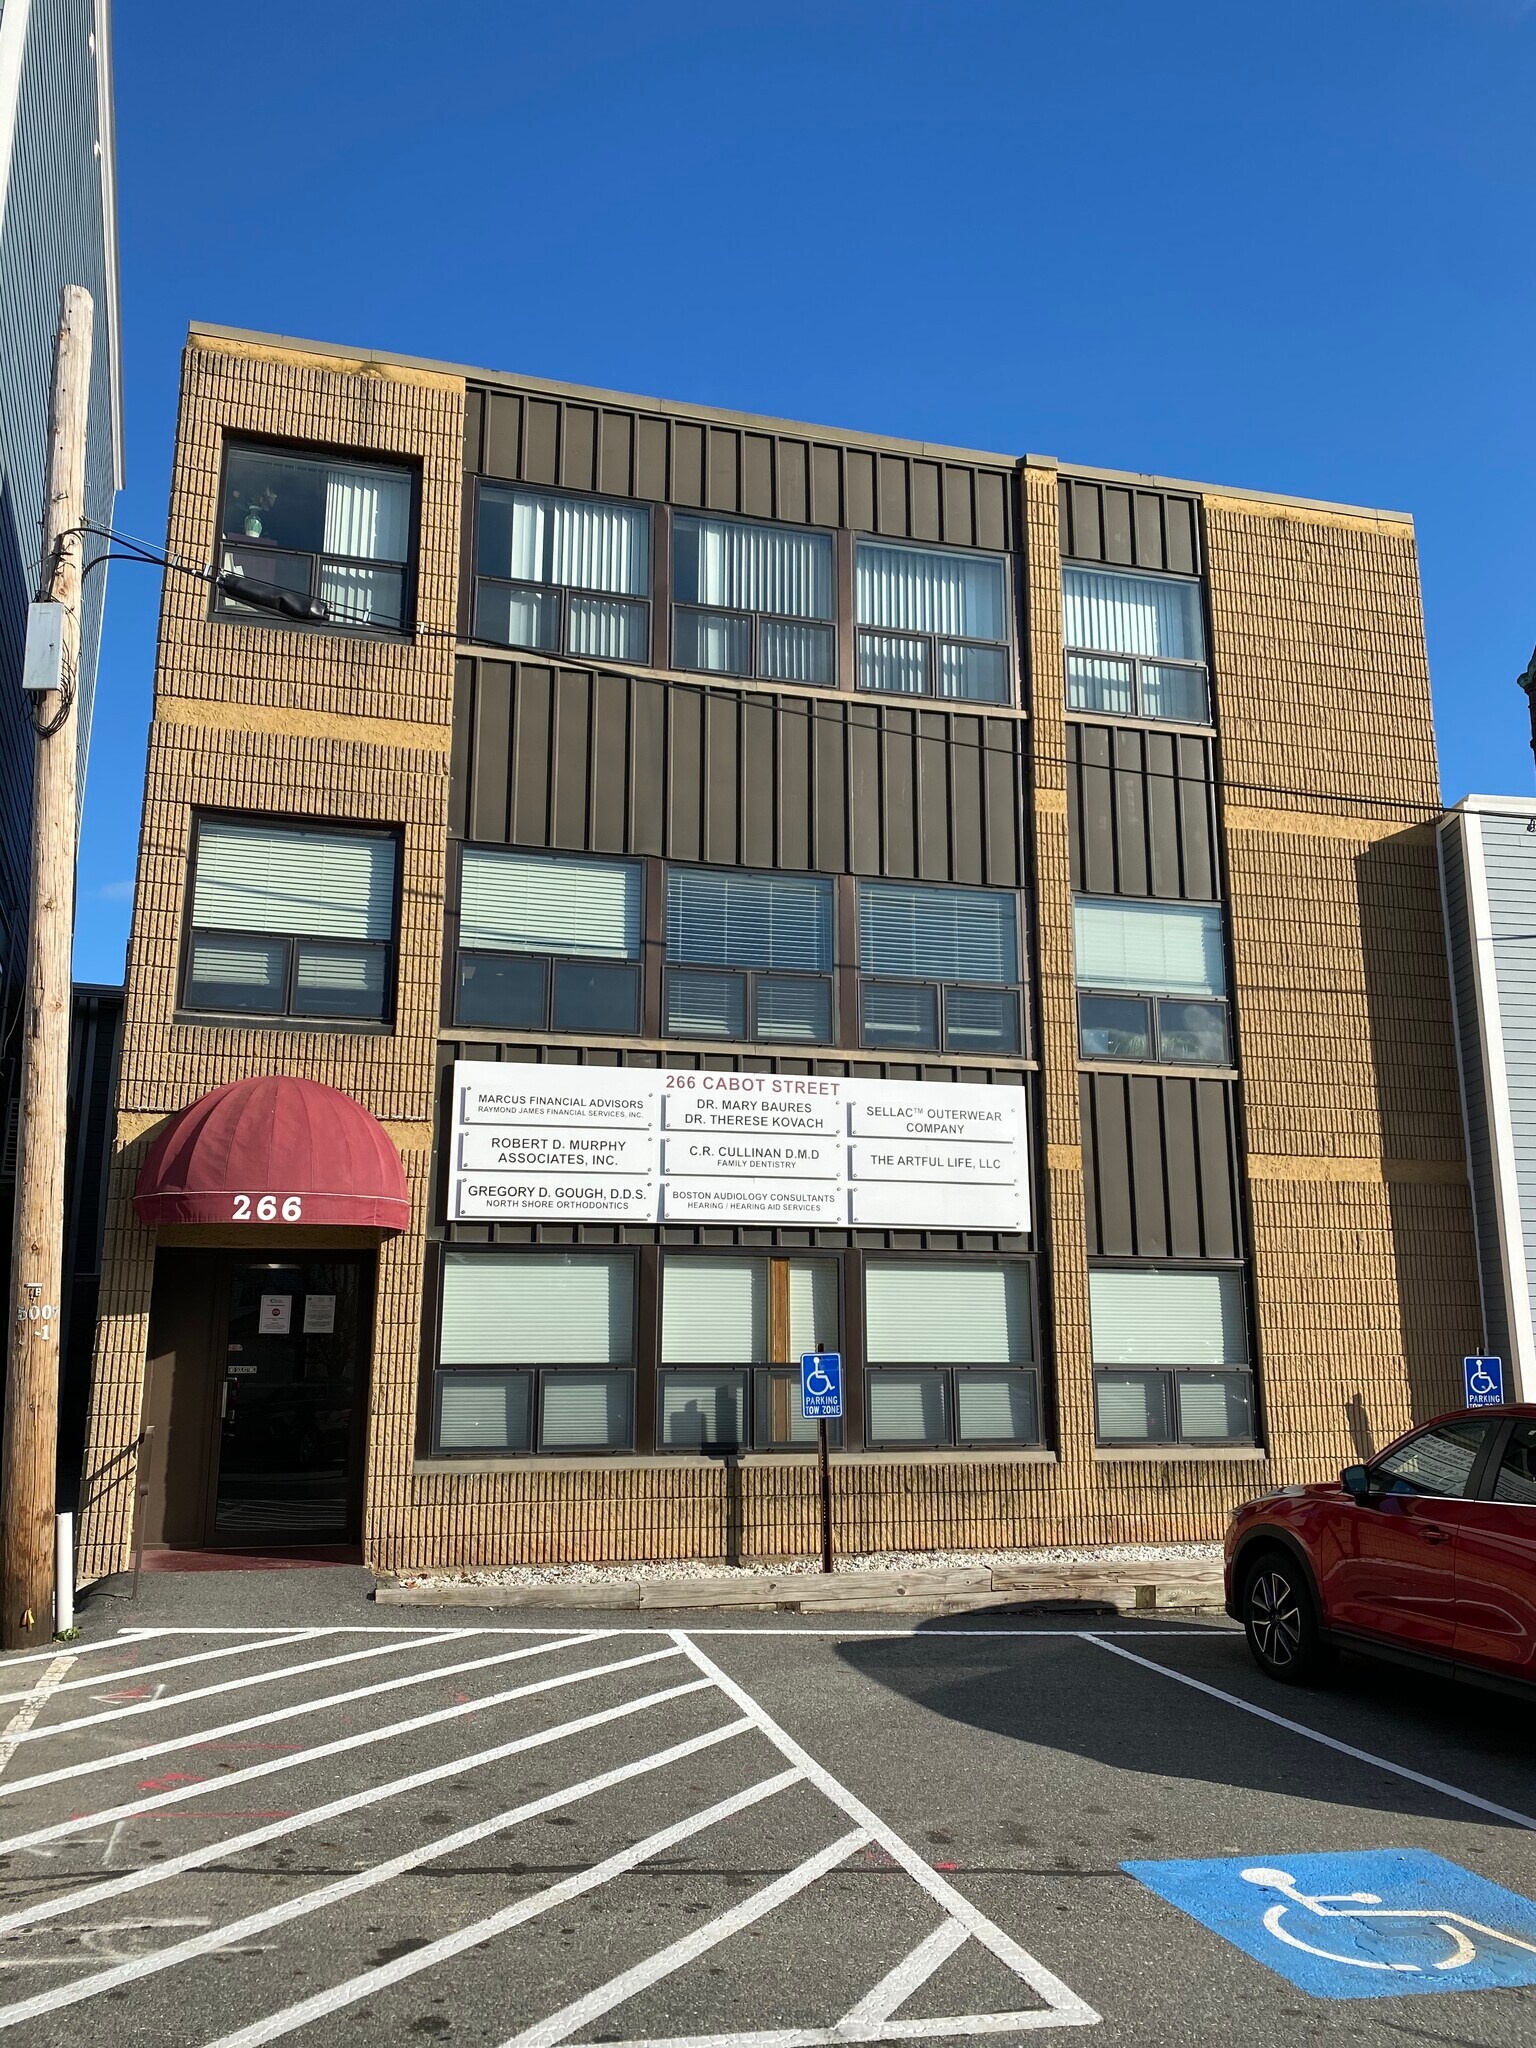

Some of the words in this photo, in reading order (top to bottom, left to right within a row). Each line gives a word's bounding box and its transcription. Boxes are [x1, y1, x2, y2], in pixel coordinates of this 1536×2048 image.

[666, 1075, 696, 1089] 266
[703, 1077, 765, 1092] CABOT
[772, 1080, 840, 1096] STREET
[478, 1095, 526, 1105] MARCUS
[530, 1096, 587, 1107] FINANCIAL
[589, 1099, 644, 1109] ADVISORS
[697, 1099, 718, 1110] DR.
[722, 1100, 758, 1112] MARY
[762, 1101, 812, 1113] BAURES
[478, 1106, 517, 1114] RAYMOND
[519, 1107, 545, 1115] JAMES
[547, 1108, 586, 1117] FINANCIAL
[588, 1110, 626, 1118] SERVICES,
[628, 1111, 643, 1119] INC.
[928, 1109, 1002, 1122] OUTERWEAR
[685, 1114, 706, 1125] DR.
[711, 1115, 769, 1127] THERESE
[772, 1117, 824, 1129] KOVACH
[906, 1123, 965, 1135] COMPANY
[491, 1137, 549, 1150] ROBERT
[552, 1140, 565, 1149] D.
[570, 1140, 626, 1152] MURPHY
[689, 1146, 714, 1157] C.R.
[718, 1147, 782, 1159] CULLINAN
[786, 1149, 820, 1160] D.M.D
[498, 1153, 588, 1167] ASSOCIATES,
[592, 1155, 618, 1166] INC.
[717, 1159, 747, 1168] FAMILY
[750, 1161, 797, 1169] DENTISTRY
[870, 1155, 895, 1165] THE
[897, 1156, 944, 1167] ARTFUL
[948, 1158, 976, 1170] LIFE,
[979, 1159, 1001, 1169] LLC
[468, 1185, 535, 1198] GREGORY
[538, 1187, 551, 1198] D.
[555, 1188, 607, 1200] GOUGH,
[610, 1189, 647, 1200] D.D.S.
[673, 1191, 711, 1199] BOSTON
[714, 1192, 767, 1202] AUDIOLOGY
[770, 1194, 835, 1203] CONSULTANTS
[232, 1195, 302, 1221] 266
[486, 1199, 519, 1208] NORTH
[521, 1200, 554, 1208] SHORE
[556, 1200, 629, 1210] ORTHODONTICS
[783, 1204, 821, 1212] SERVICES
[806, 1396, 838, 1405] PARKING
[1469, 1395, 1500, 1403] PARKING
[806, 1406, 820, 1415] TOW
[822, 1405, 840, 1414] ZONE
